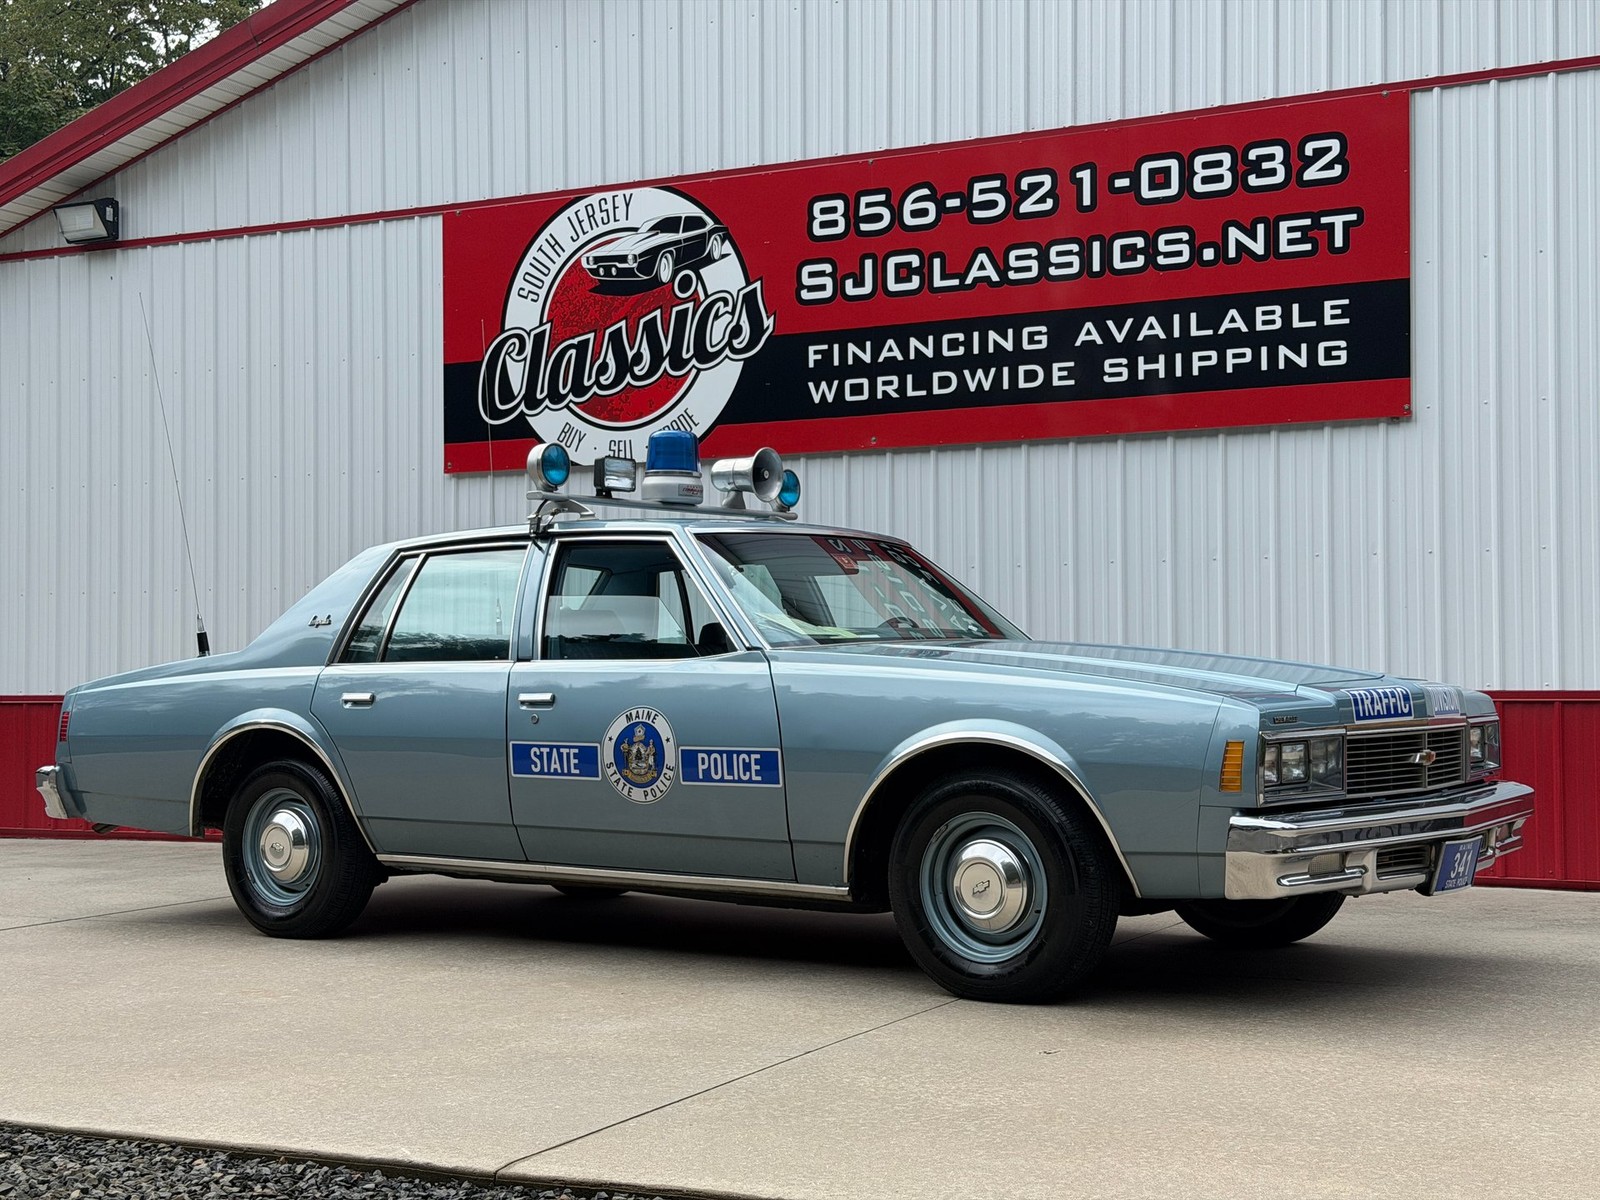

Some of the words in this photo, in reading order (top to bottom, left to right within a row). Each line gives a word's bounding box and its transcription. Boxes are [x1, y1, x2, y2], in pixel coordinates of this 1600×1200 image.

[810, 136, 1345, 239] 856-521-0832
[517, 233, 566, 303] SOUTH
[567, 193, 634, 243] JERSEY
[799, 211, 1360, 301] SJCLASSICS.NET
[478, 276, 775, 425] Classics
[807, 325, 1050, 369] FINANCING
[1074, 299, 1351, 347] AVAILABLE
[807, 361, 1076, 404] WORLDWIDE
[1101, 340, 1349, 383] SHIPPING
[556, 422, 587, 452] BUY
[625, 709, 659, 724] MAINE
[1350, 687, 1409, 717] TRAFFIC
[530, 747, 580, 774] STATE
[697, 752, 762, 781] POLICE
[606, 761, 633, 797] STATE
[643, 763, 674, 800] POLICE
[1450, 850, 1473, 878] 341
